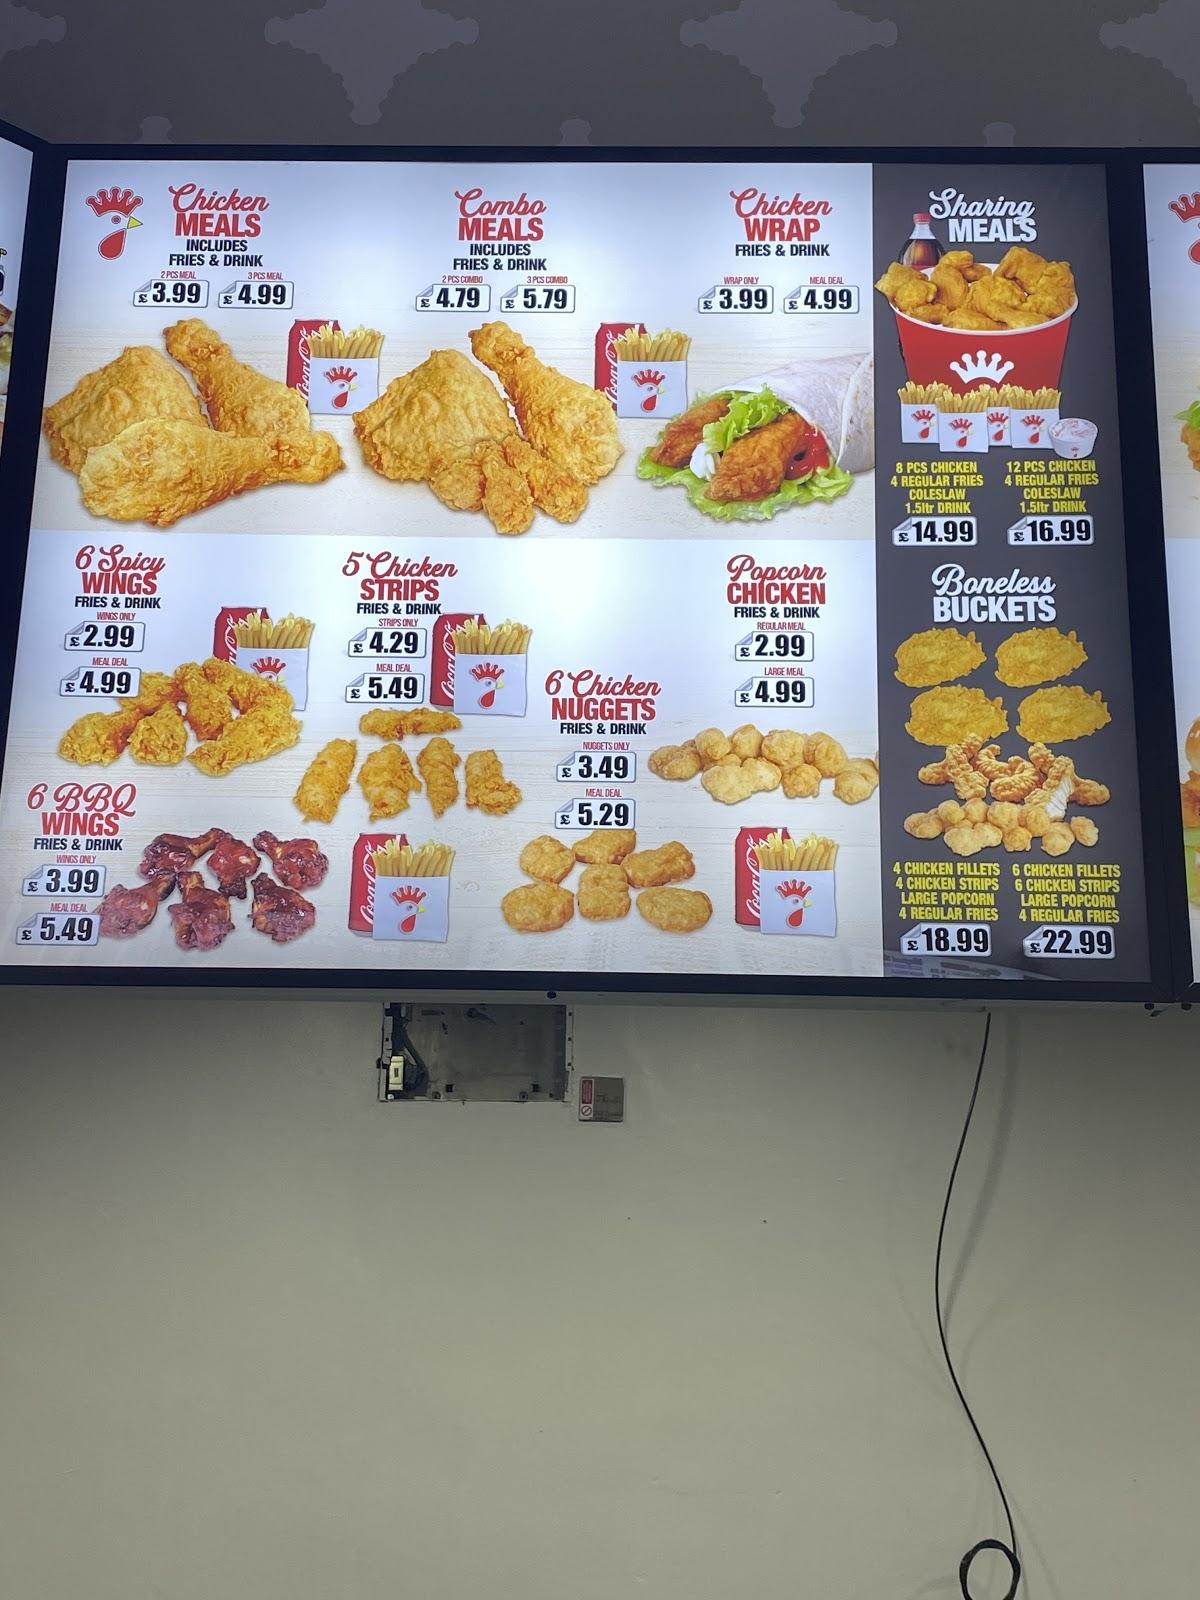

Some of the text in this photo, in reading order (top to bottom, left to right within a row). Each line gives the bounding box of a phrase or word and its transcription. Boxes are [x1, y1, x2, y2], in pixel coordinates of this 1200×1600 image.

[168, 183, 269, 212] Chicken
[454, 188, 547, 218] Combo
[730, 188, 832, 218] Chicken
[929, 188, 1036, 224] Sharing
[175, 213, 261, 237] MEALS
[459, 218, 544, 241] MEALS
[744, 218, 820, 242] WRAP
[949, 218, 1037, 242] MEALS
[186, 239, 248, 251] INCLUDES
[470, 244, 531, 256] INCLUDES
[735, 244, 830, 256] FRIES & DRINK
[169, 254, 263, 266] FRIES & DRINK
[453, 258, 547, 271] FRIES & DRINK
[532, 276, 545, 284] PCS
[546, 276, 568, 284] COMBO
[896, 461, 977, 473] 8 PCS CHICKEN
[1007, 460, 1096, 472] 12 PCS CHICKEN
[891, 475, 983, 487] 4 REGULAR FRIES
[1005, 474, 1099, 486] 4 REGULAR FRIES
[909, 488, 966, 500] COLESLAW
[1024, 487, 1081, 499] COLESLAW
[938, 502, 971, 513] DRINK
[1053, 501, 1086, 512] DRINK
[75, 544, 166, 578] 6 Spicy
[342, 551, 458, 579] 5 Chicken
[726, 554, 827, 583] Popcorn
[82, 572, 157, 595] WINGS
[931, 563, 1056, 596] Boneless
[360, 579, 439, 601] STRIPS
[727, 582, 825, 604] CHICKEN
[75, 596, 161, 609] FRIES & DRINK
[357, 603, 442, 615] FRIES & DRINK
[933, 595, 1057, 622] BUCKETS
[97, 612, 136, 621] WINGS ONLY
[734, 607, 820, 618] FRIES & DRINK
[403, 619, 418, 627] ONLY
[757, 622, 805, 630] REGULAR MEAL
[92, 657, 128, 666] MEAL DEAL
[377, 664, 411, 672] MEAL DEAL
[765, 667, 804, 676] LARGE MEAL
[545, 670, 661, 697] 6 Chicken
[552, 698, 656, 720] NUGGETS
[560, 723, 646, 734] FRIES & DRINK
[583, 742, 630, 750] NUGGETS ONLY
[27, 782, 137, 817] 6 BBQ
[586, 789, 622, 797] MEAL DEAL
[42, 812, 119, 836] WINGS
[34, 838, 123, 850] FRIES & DRINK
[57, 855, 96, 864] WINGS ONLY
[893, 862, 1000, 876] 4 CHICKEN FILLETS
[1013, 864, 1121, 877] 6 CHICKEN FILLETS
[896, 877, 999, 891] 4 CHICKEN STRIPS
[1015, 879, 1120, 893] 6 CHICKEN STRIPS
[901, 892, 994, 906] LARGE POPCORN
[1021, 894, 1115, 908] LARGE POPCORN
[51, 903, 87, 912] MEAL DEAL
[899, 908, 998, 921] 4 REGULAR FRIES
[1019, 909, 1120, 923] 4 REGULAR FRIES
